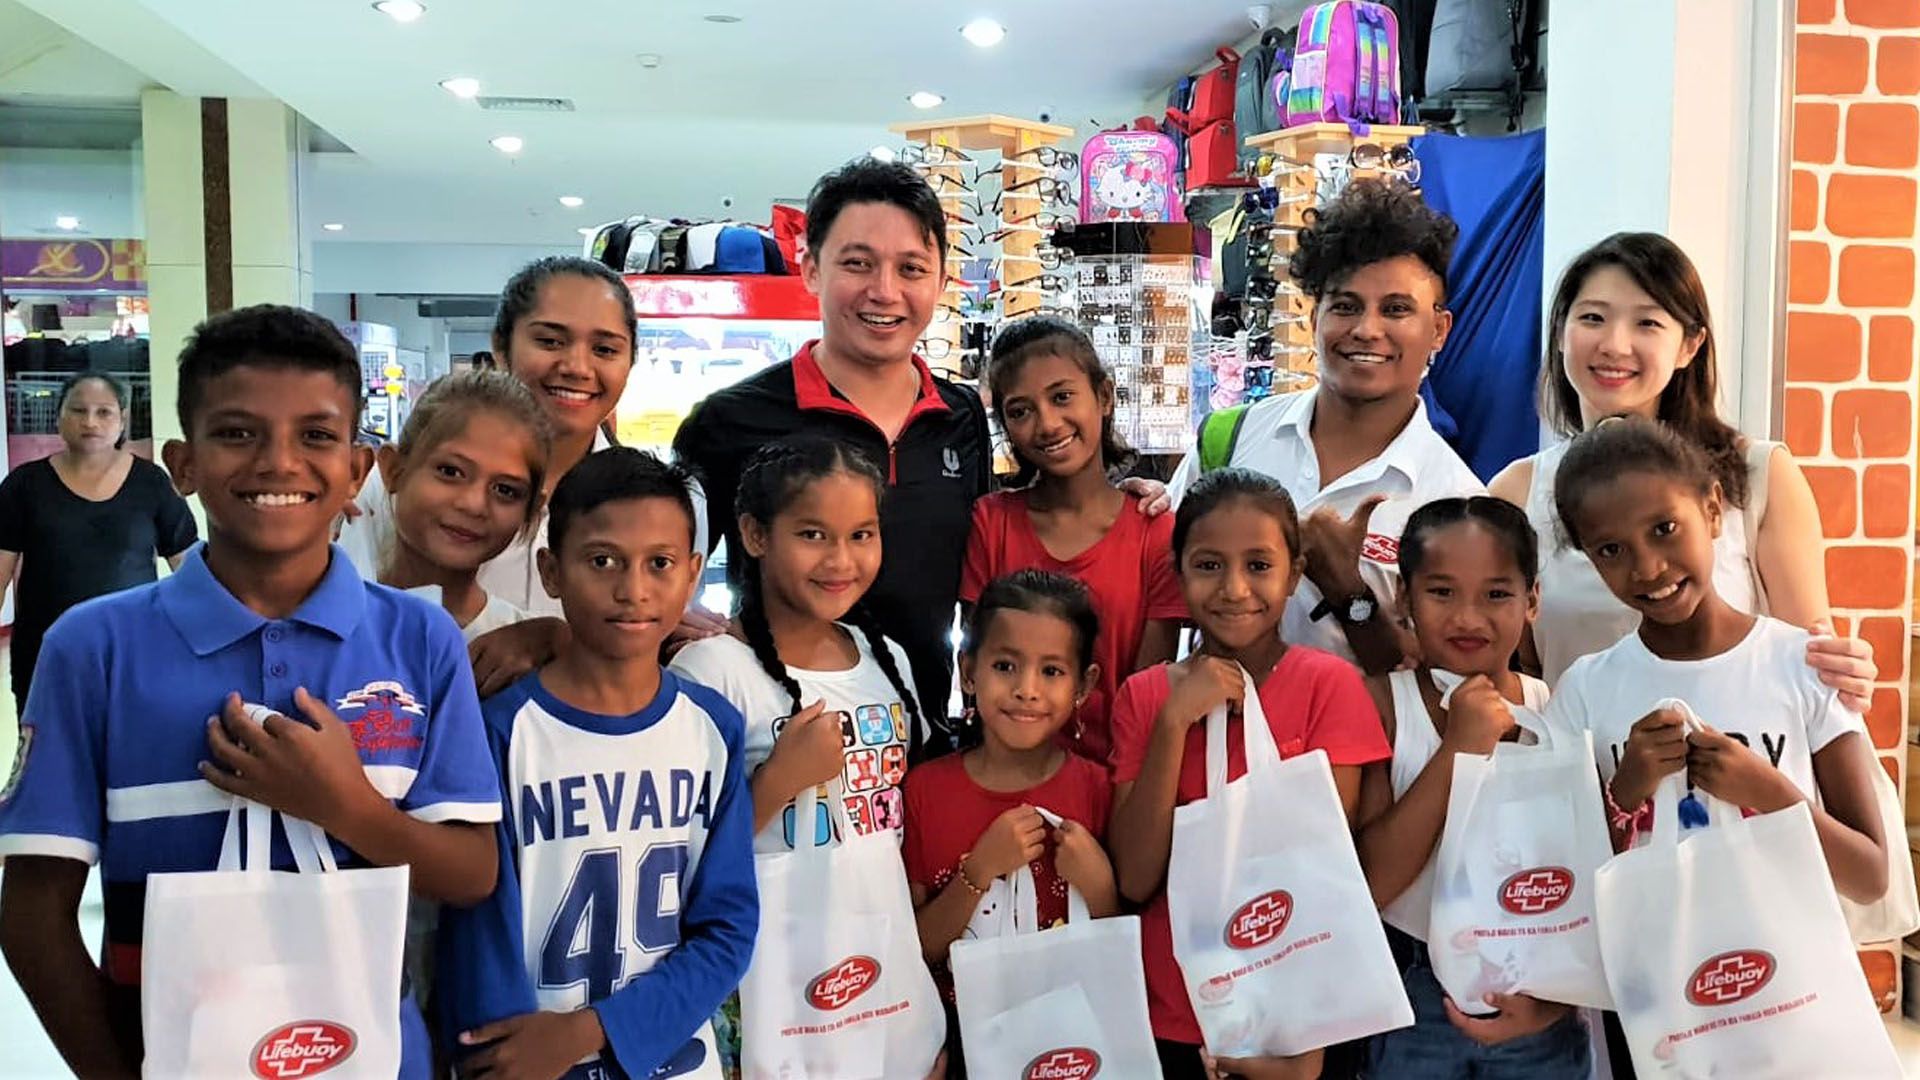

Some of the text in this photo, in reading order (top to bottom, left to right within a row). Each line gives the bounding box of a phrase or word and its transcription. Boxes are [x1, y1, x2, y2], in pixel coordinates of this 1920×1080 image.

[522, 768, 713, 847] NEVADA
[1505, 883, 1569, 899] Lifebuoy
[537, 841, 692, 1010] 49
[1232, 902, 1288, 937] Lifebuoy
[814, 971, 873, 996] Lifebuoy
[1695, 964, 1768, 992] Lifebuoy
[260, 1041, 345, 1061] Lifebuoy
[1030, 1063, 1093, 1080] Lifebuoy
